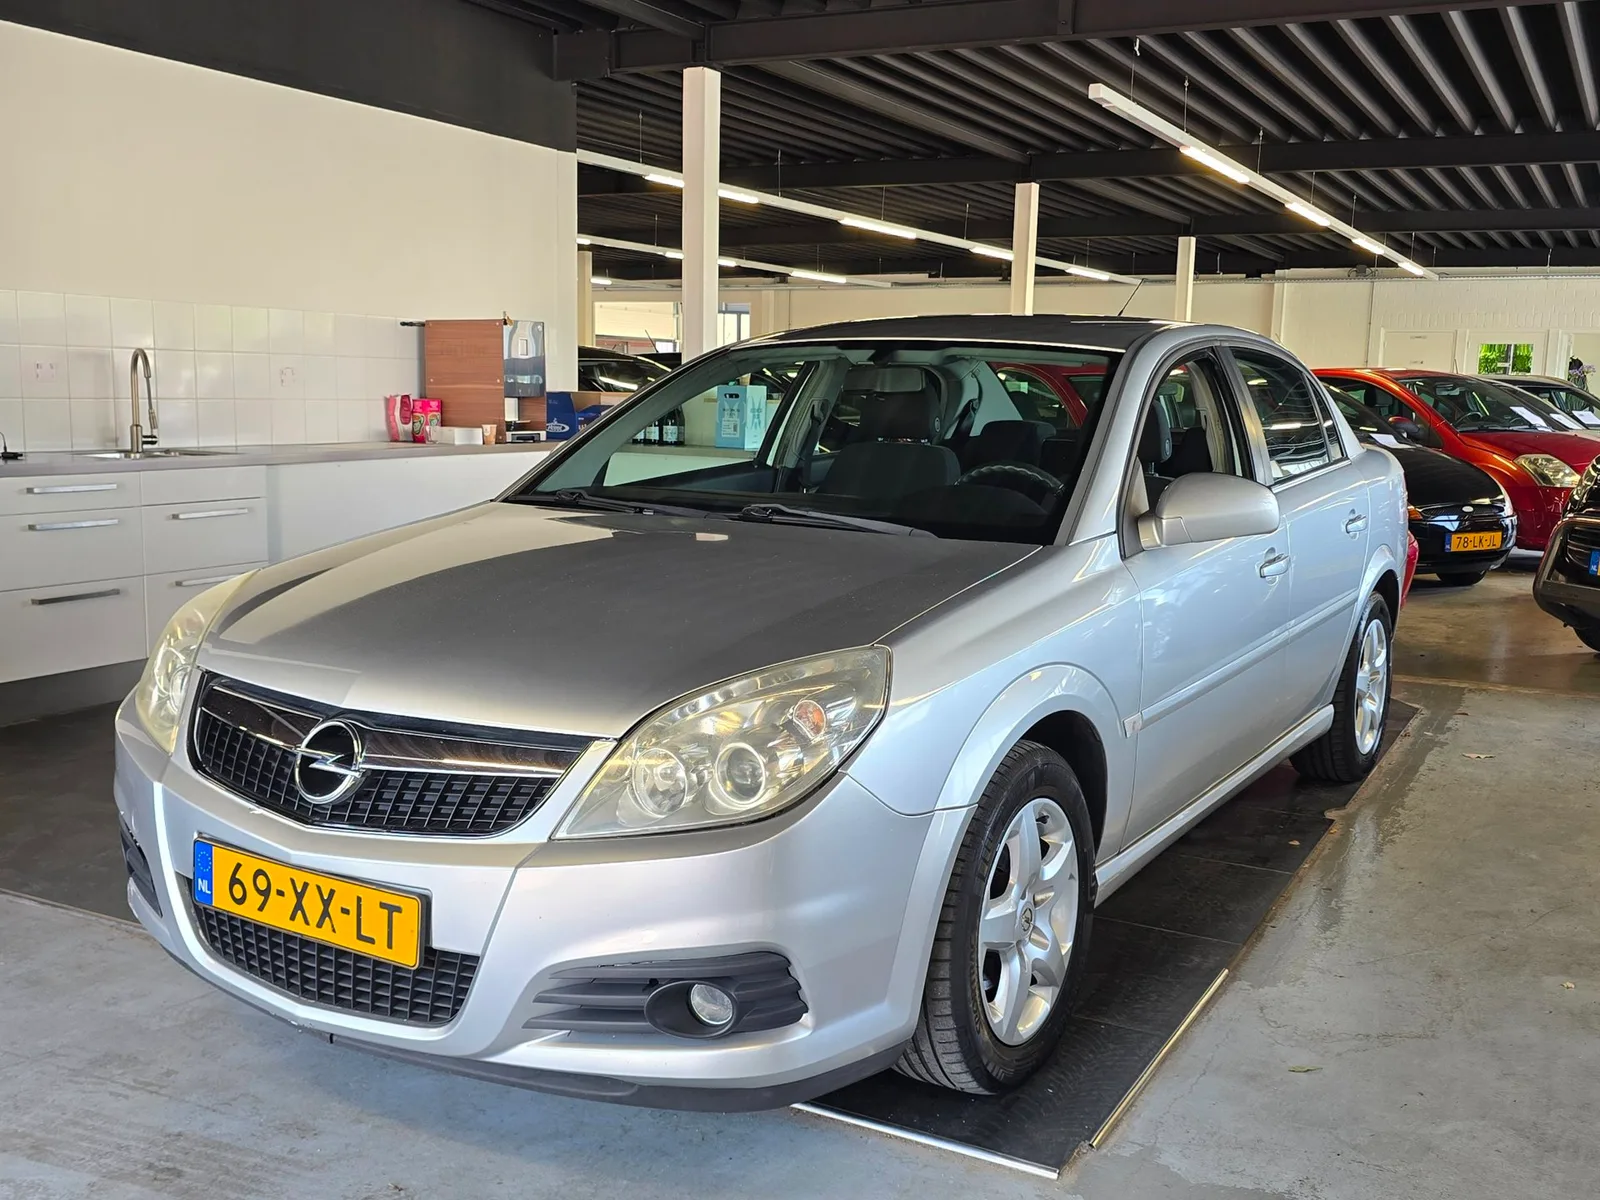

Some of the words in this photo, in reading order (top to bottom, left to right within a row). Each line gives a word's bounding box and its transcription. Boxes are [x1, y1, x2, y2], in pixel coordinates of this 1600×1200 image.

[1456, 534, 1496, 549] 78-LK-JL
[197, 877, 212, 895] NL
[228, 862, 403, 950] 69-XX-LT
